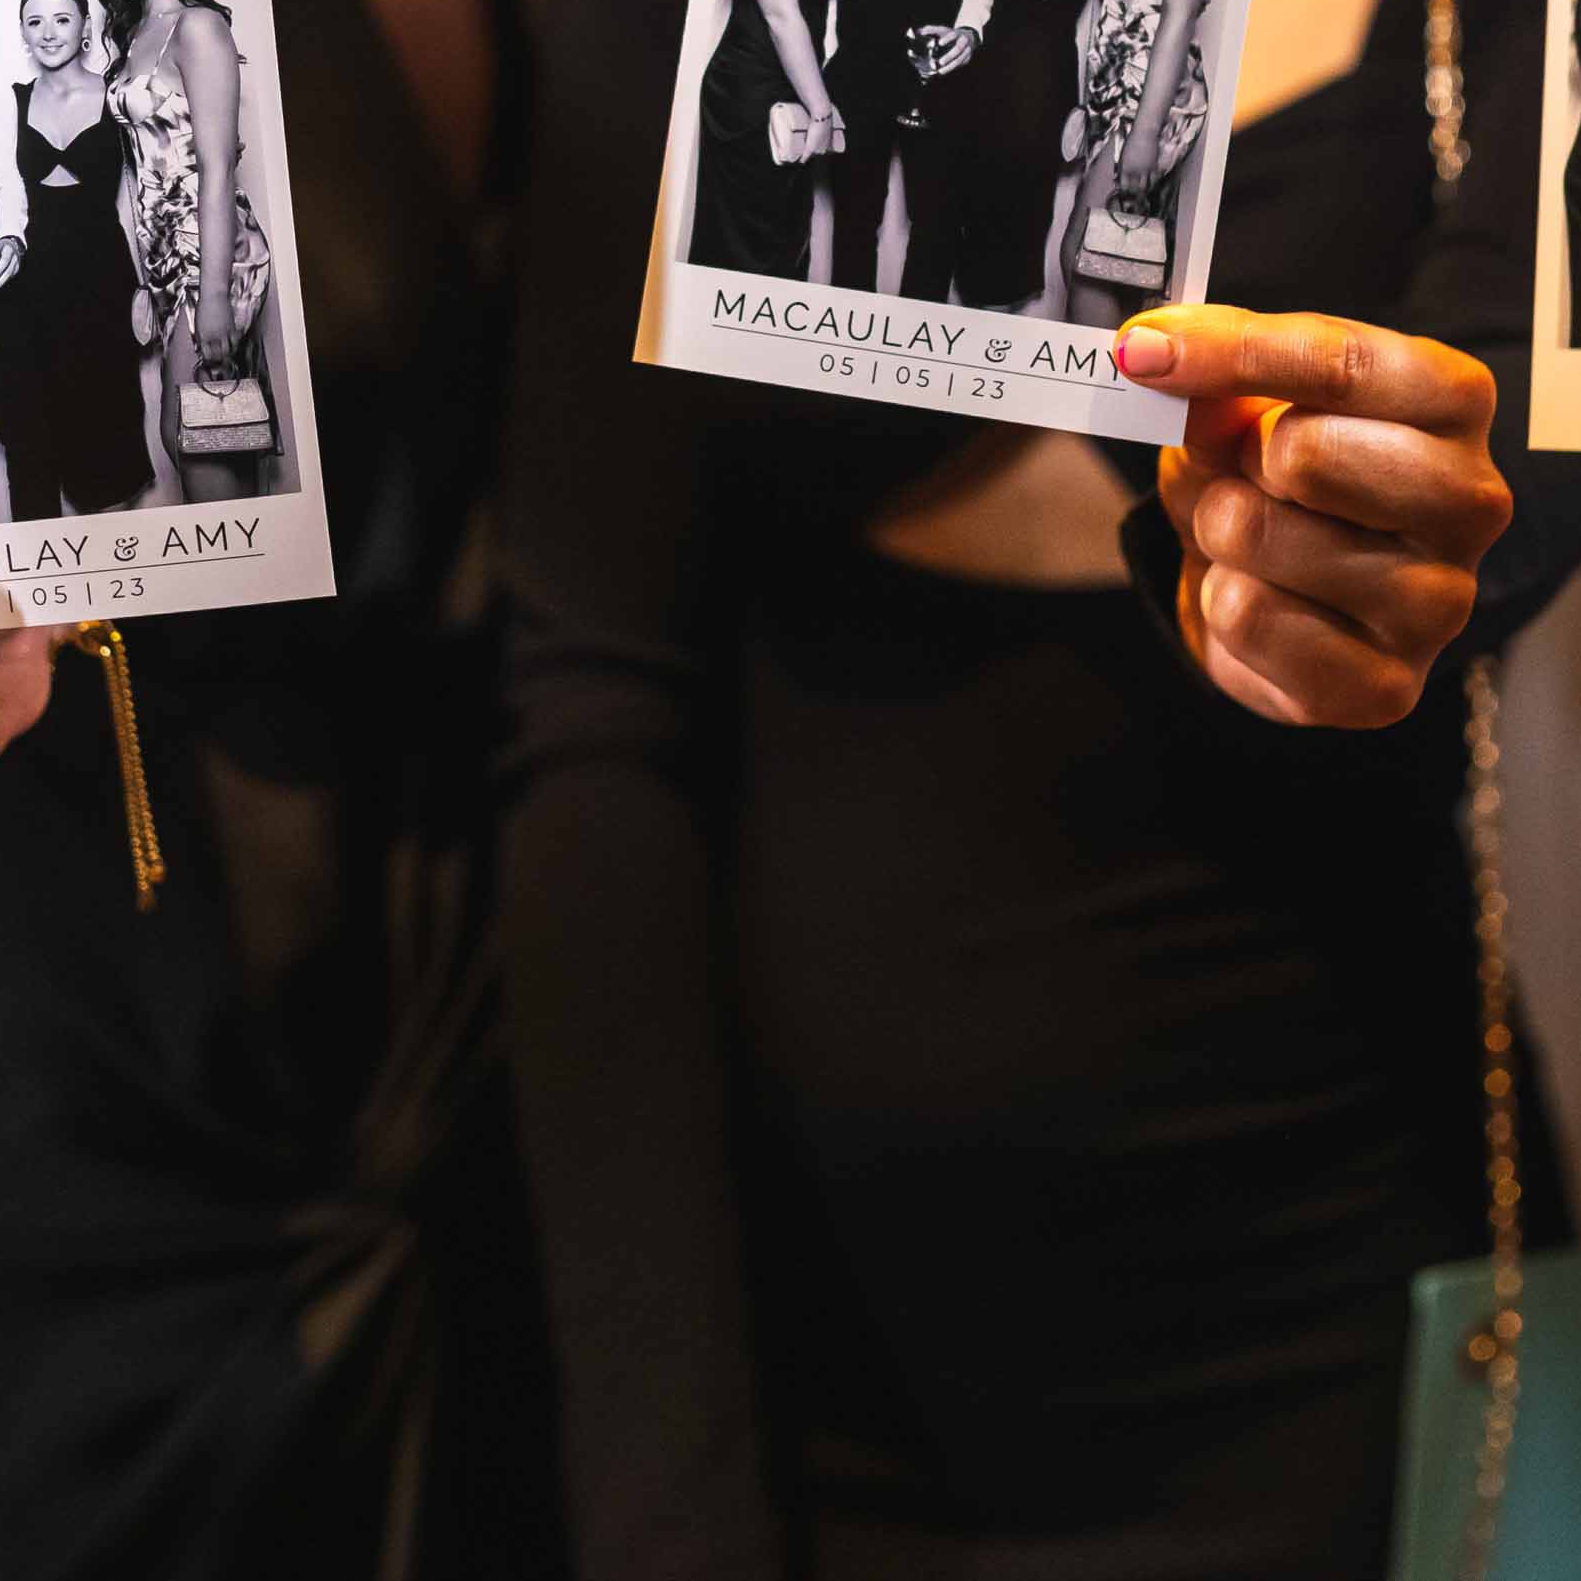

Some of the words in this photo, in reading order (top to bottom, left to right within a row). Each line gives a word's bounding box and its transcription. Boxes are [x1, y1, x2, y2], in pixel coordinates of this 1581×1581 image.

[713, 288, 966, 357] MACAULAY
[984, 337, 1013, 363] &
[818, 353, 855, 377] 05
[895, 365, 931, 389] 05
[970, 377, 1006, 400] 23
[113, 535, 140, 562] &
[161, 517, 260, 558] AMY
[31, 584, 68, 606] 05
[109, 576, 145, 600] 23
